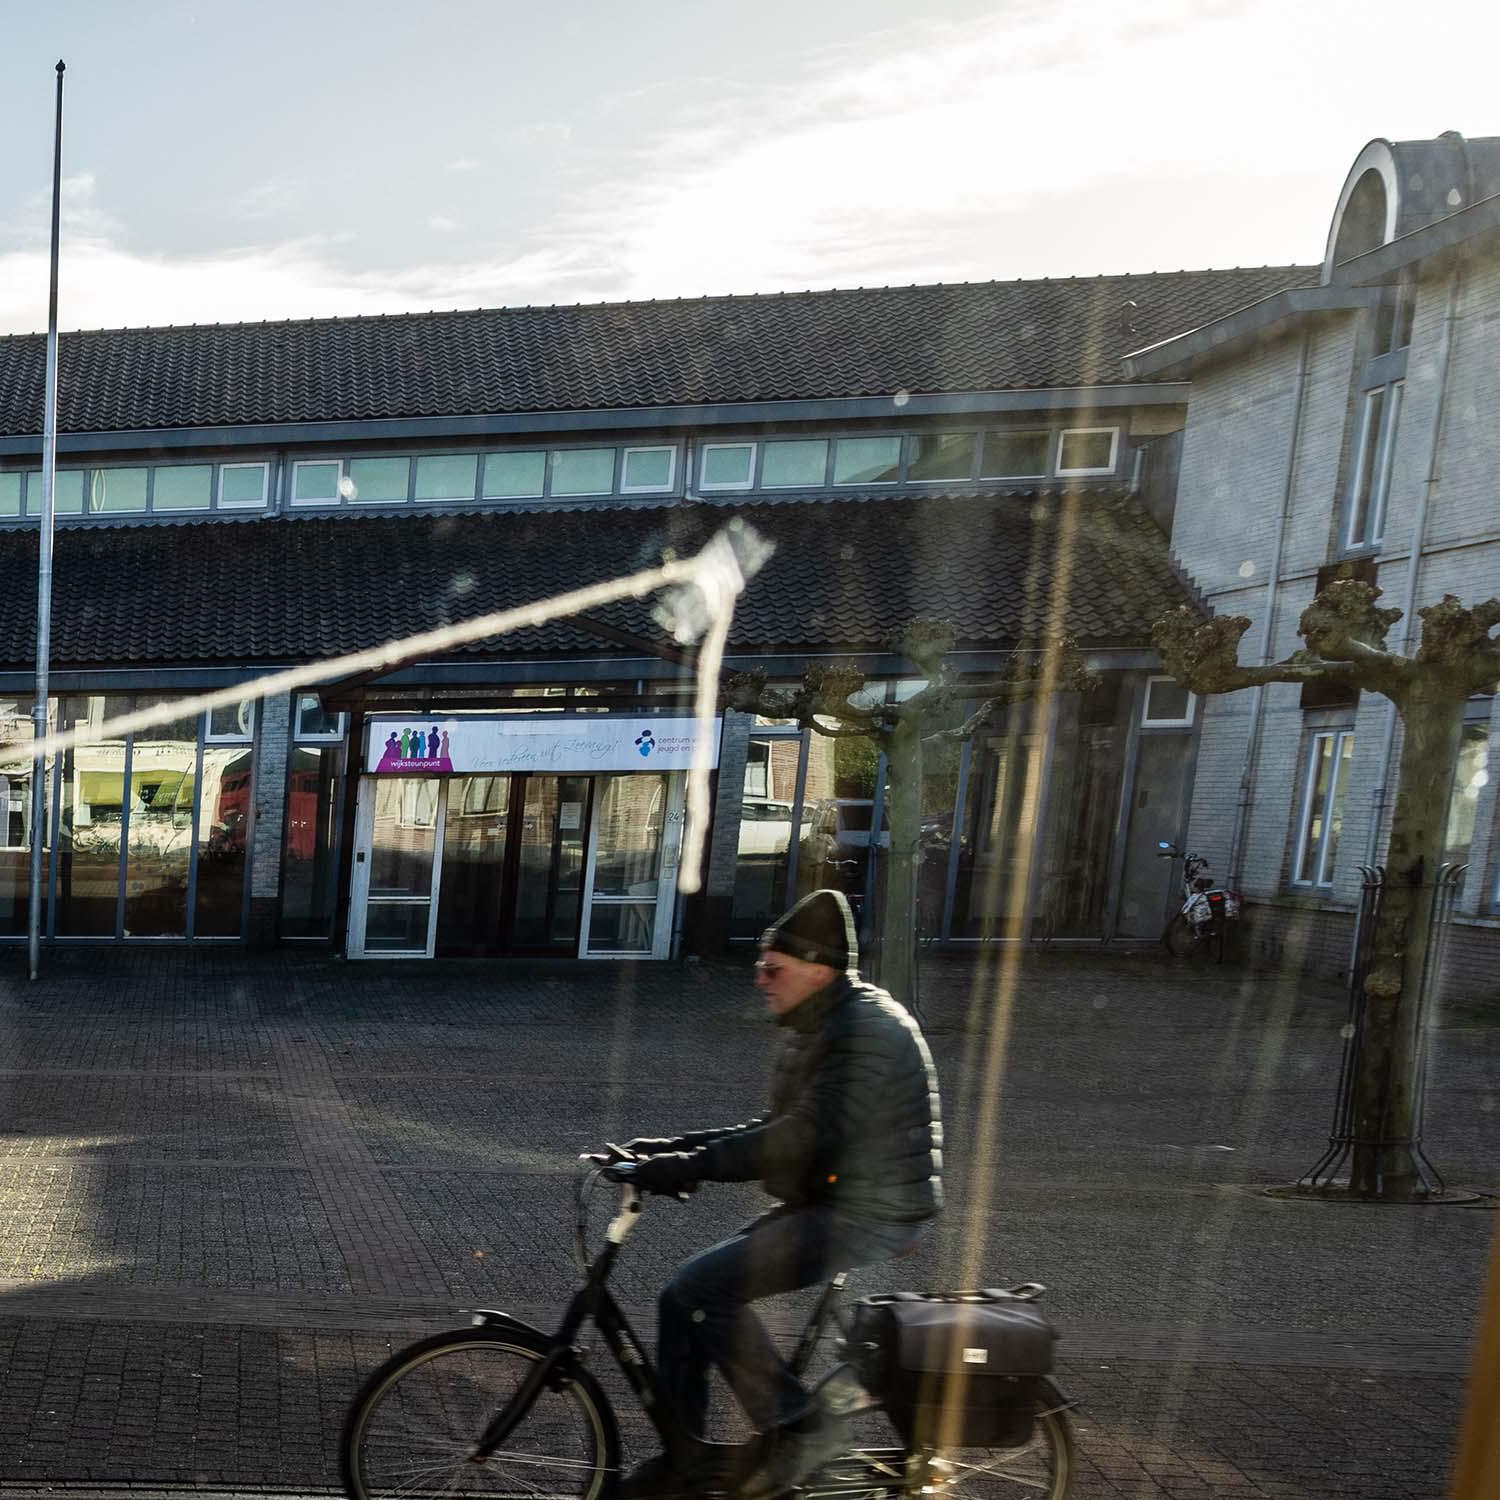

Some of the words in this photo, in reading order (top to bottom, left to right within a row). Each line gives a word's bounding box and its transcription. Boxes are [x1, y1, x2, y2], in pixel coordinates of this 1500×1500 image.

[658, 736, 690, 744] centrum
[657, 745, 680, 754] jeugd
[390, 760, 441, 769] wijksteunpunt
[667, 811, 680, 822] 24
